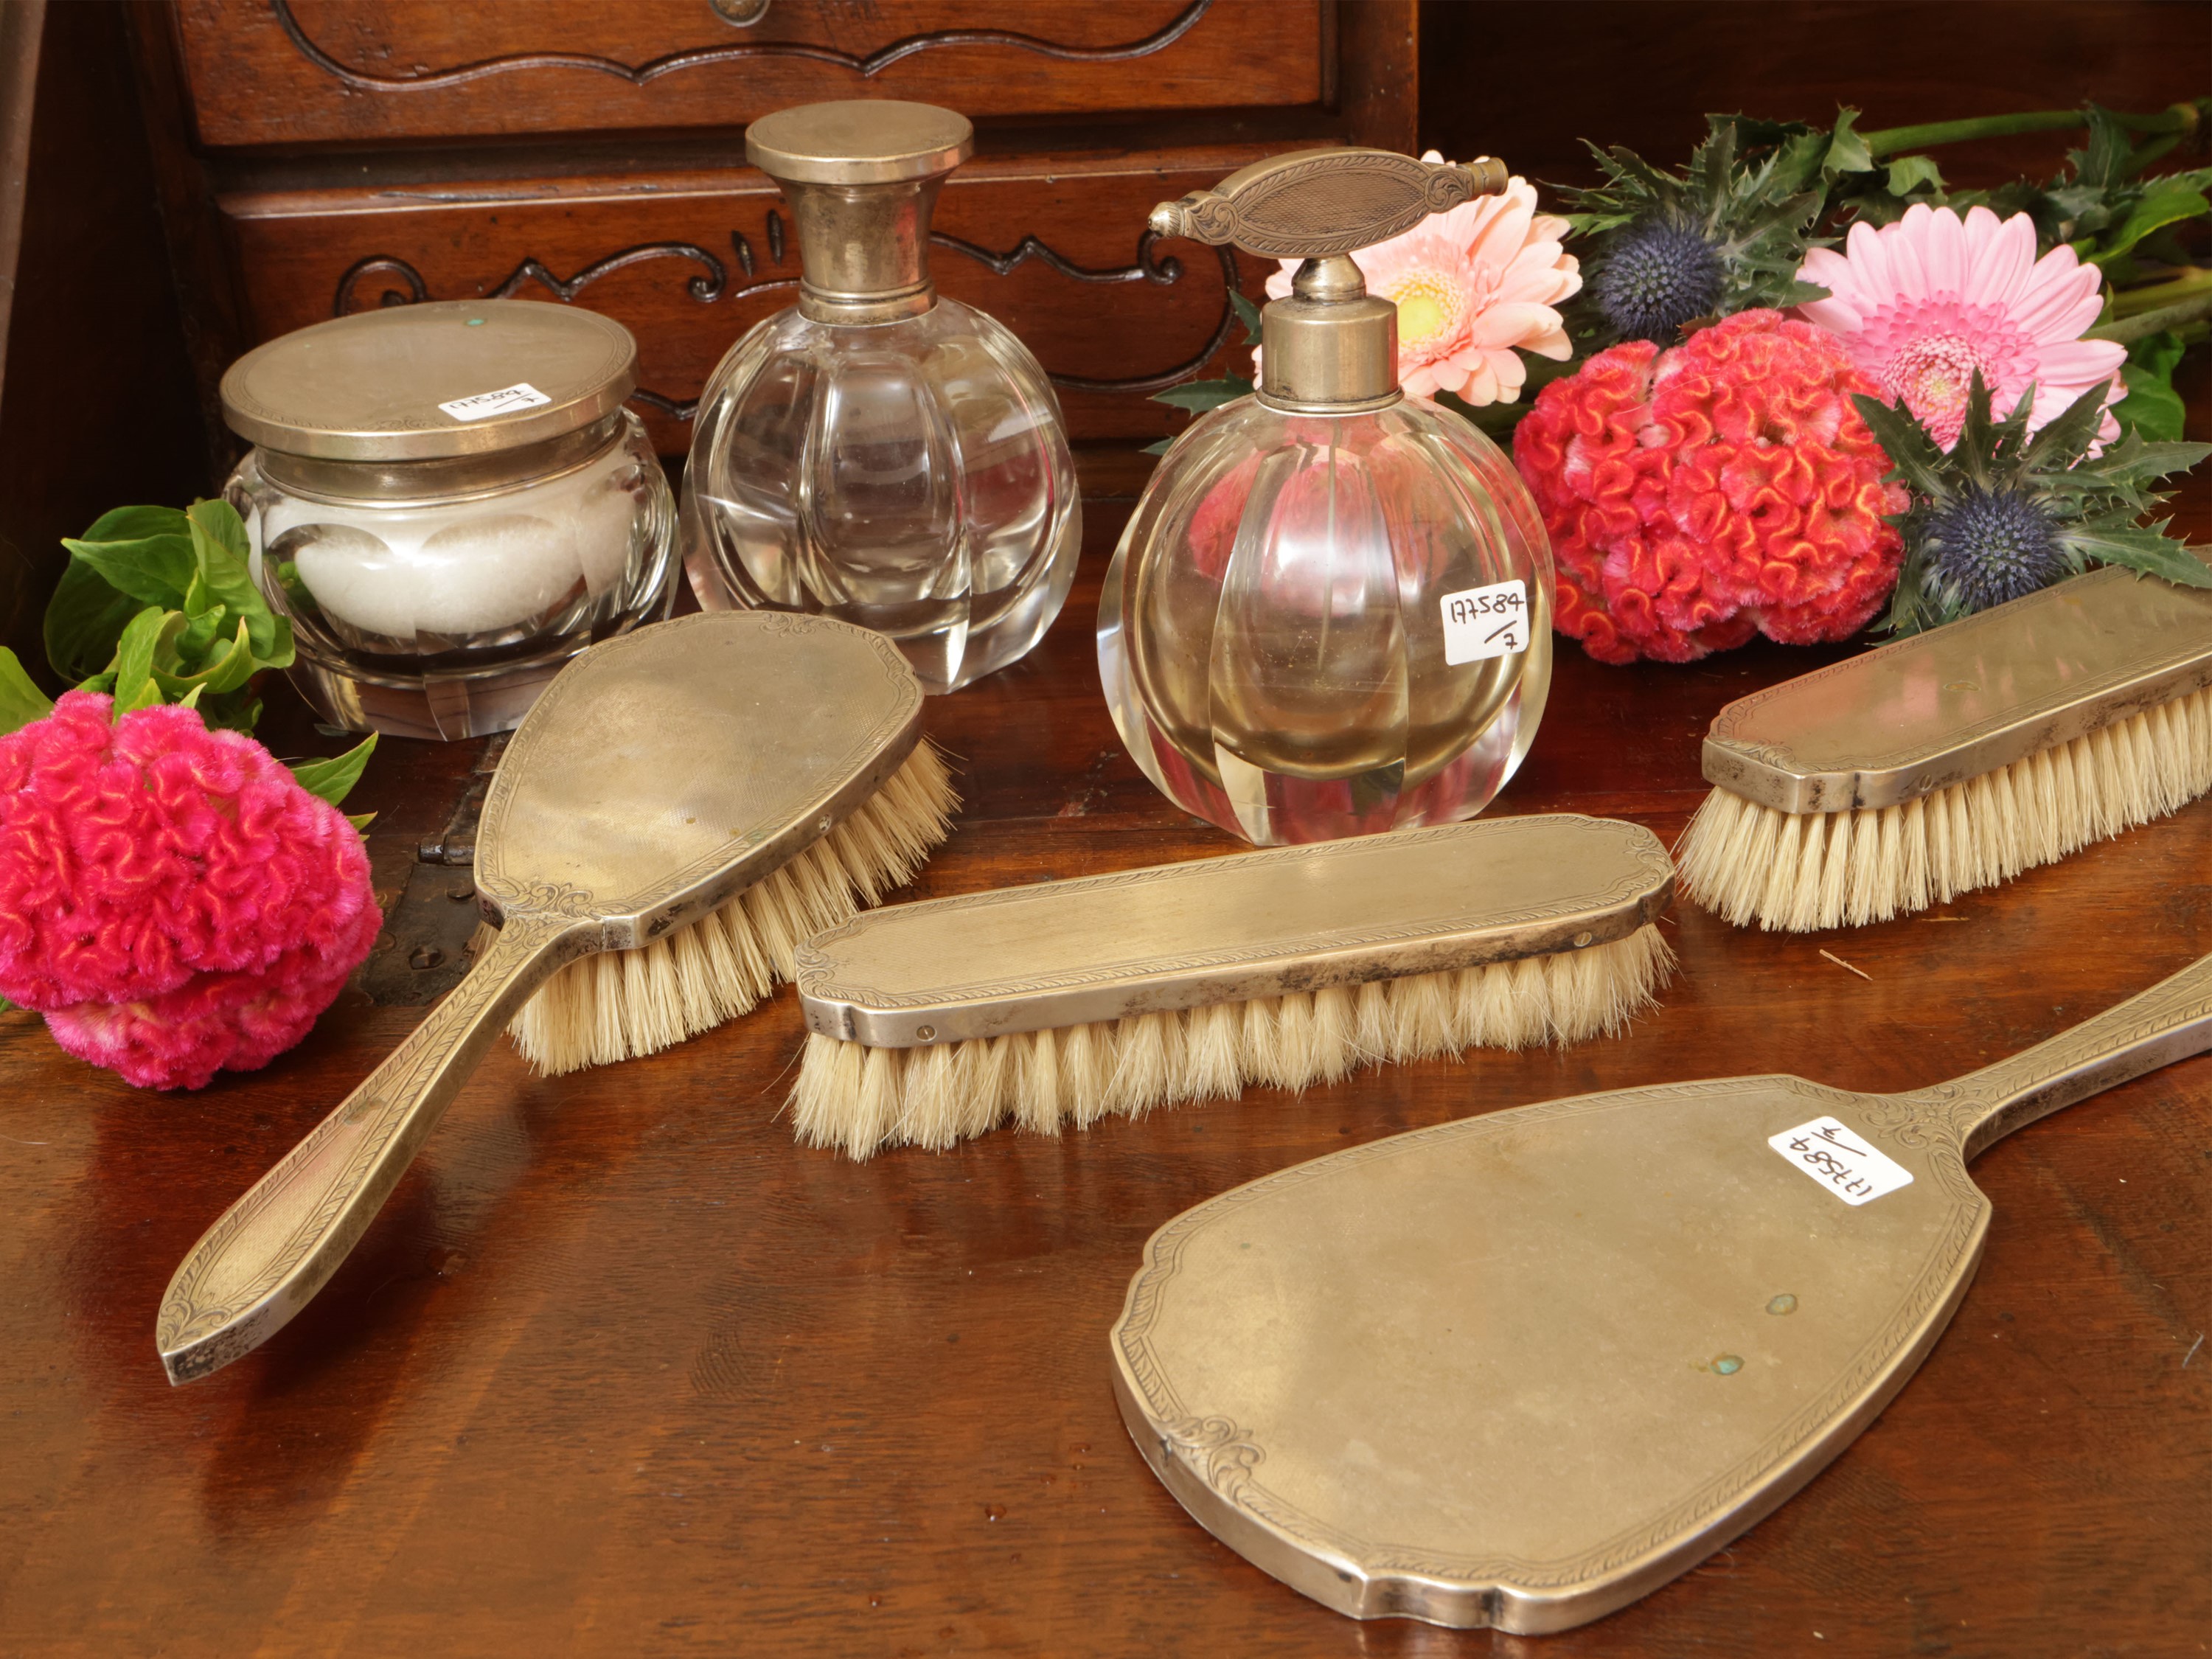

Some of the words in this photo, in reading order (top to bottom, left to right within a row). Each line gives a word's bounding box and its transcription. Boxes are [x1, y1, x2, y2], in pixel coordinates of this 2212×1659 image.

[449, 389, 525, 409] 177584
[1451, 593, 1525, 625] 177584
[1790, 1137, 1873, 1197] 177584
